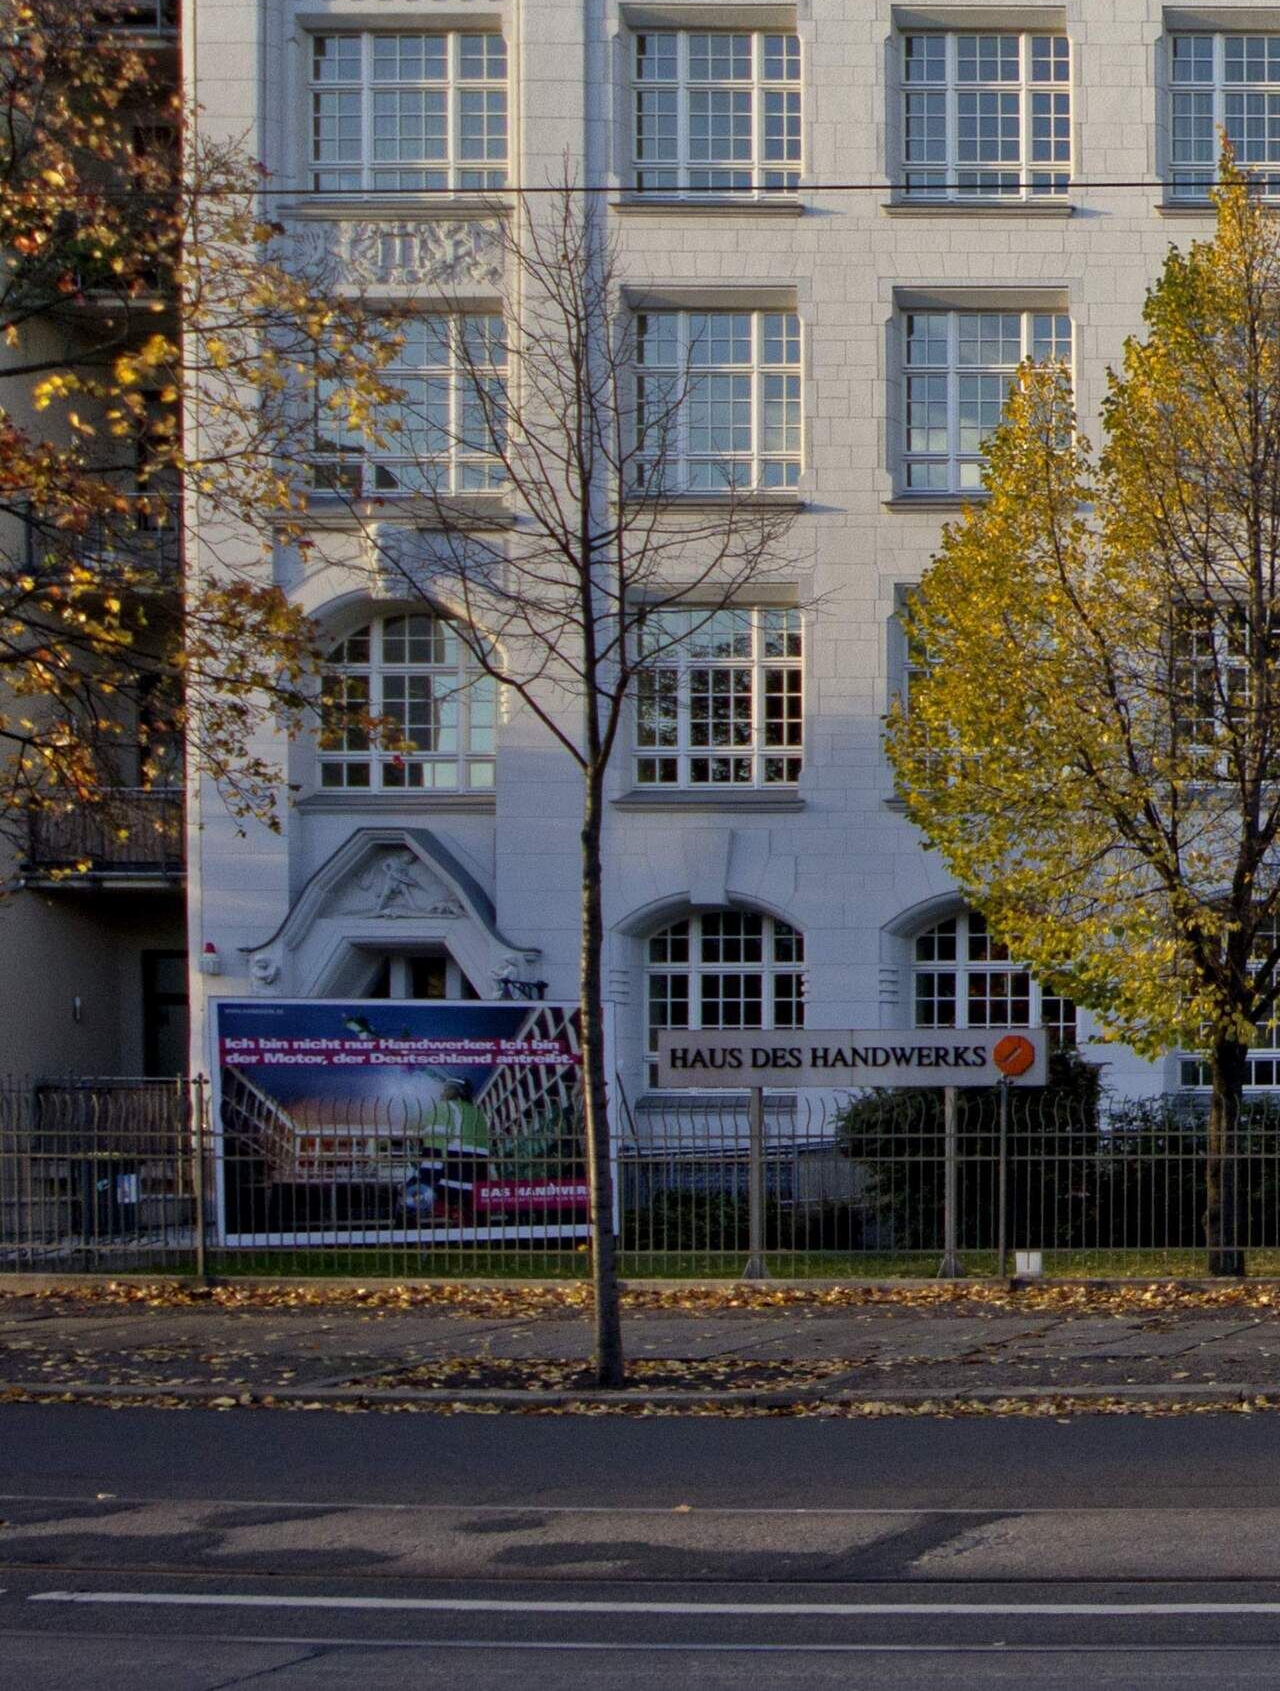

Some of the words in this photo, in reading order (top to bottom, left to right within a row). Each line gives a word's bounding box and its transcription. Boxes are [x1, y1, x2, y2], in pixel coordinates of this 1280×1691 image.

[224, 1037, 255, 1050] Ich
[258, 1037, 289, 1050] bin
[292, 1038, 342, 1050] nicht
[344, 1040, 377, 1050] nur
[379, 1037, 497, 1051] Handwerker.
[500, 1038, 529, 1050] Ich
[531, 1038, 560, 1050] bin
[225, 1052, 260, 1064] der
[263, 1052, 328, 1066] Motor,
[331, 1052, 366, 1064] der
[369, 1052, 492, 1064] Deutschland
[495, 1052, 575, 1064] antreibt.
[669, 1047, 744, 1069] HAUS
[750, 1047, 803, 1069] DES
[809, 1045, 988, 1068] HANDWERKS
